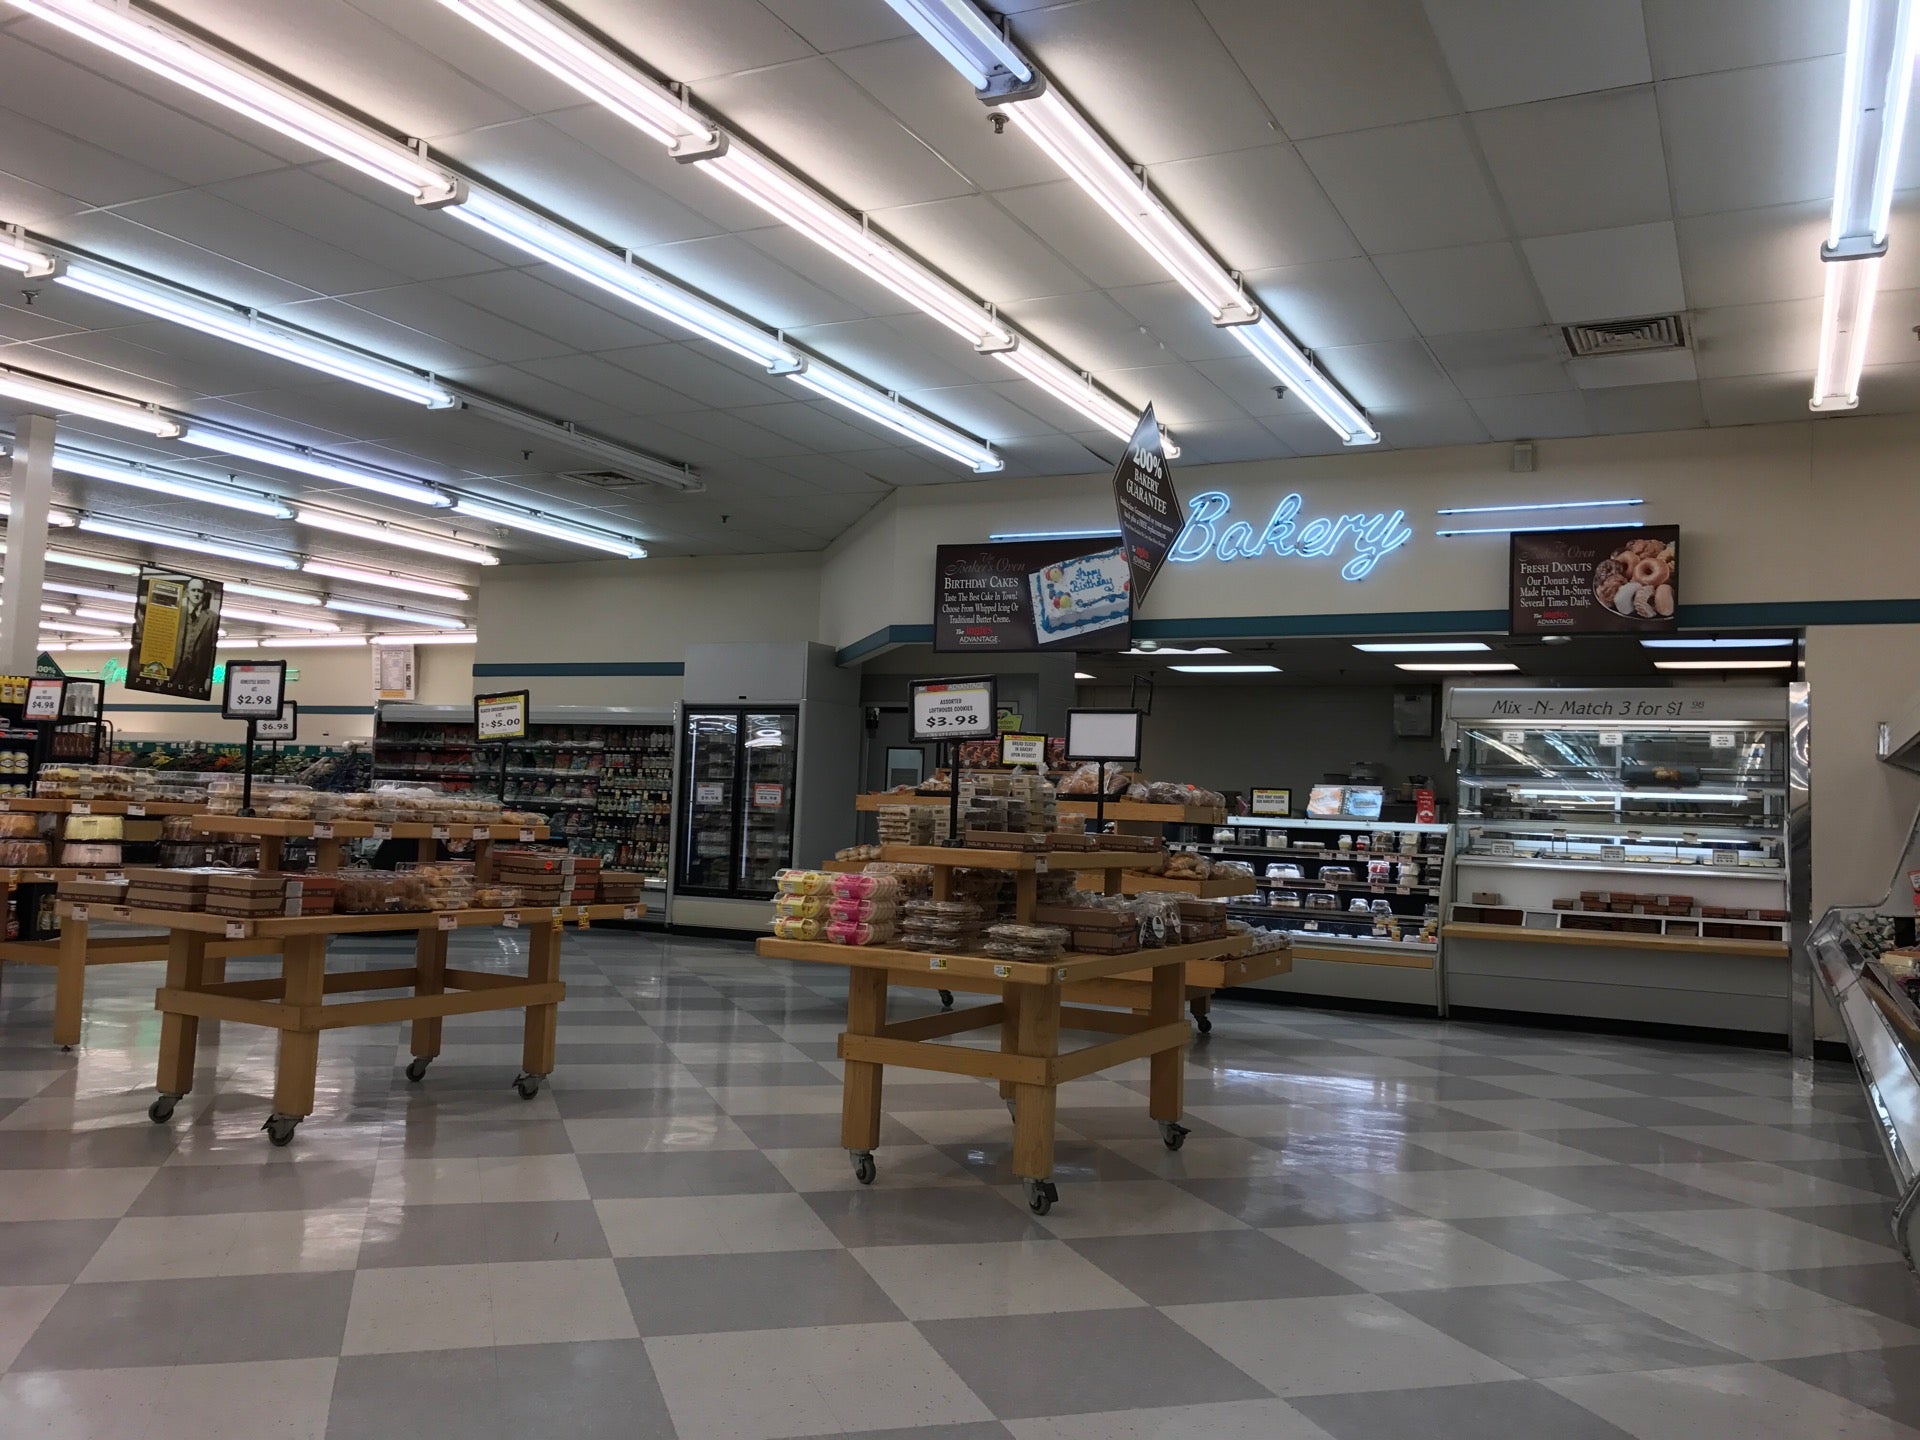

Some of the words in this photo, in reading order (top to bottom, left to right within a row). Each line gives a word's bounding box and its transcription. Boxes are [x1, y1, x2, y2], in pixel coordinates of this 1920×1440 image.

[1132, 442, 1163, 479] 200%
[1134, 467, 1160, 494] BAKERY
[1126, 478, 1167, 515] GUARANTEE
[1167, 490, 1412, 581] Bakery
[1075, 567, 1102, 581] Happy
[1520, 562, 1549, 574] FRESH
[1551, 561, 1592, 573] DONUTS
[944, 577, 988, 590] BIRTHDAY
[989, 575, 1019, 588] CAKES
[1069, 577, 1115, 593] Birthday
[1526, 575, 1541, 586] Our
[1543, 575, 1569, 586] Donuts
[1570, 574, 1585, 585] Are
[943, 592, 957, 602] Taste
[958, 592, 968, 601] The
[968, 591, 980, 601] Best
[980, 591, 994, 601] Cake
[994, 591, 1001, 600] In
[1001, 590, 1018, 601] Town!
[1519, 586, 1539, 597] Made
[1540, 586, 1561, 597] Fresh
[1562, 585, 1592, 596] In-Store
[942, 603, 960, 613] Choose
[960, 603, 975, 613] From
[974, 602, 997, 615] Whipped
[997, 602, 1011, 614] Icing
[1011, 602, 1019, 612] Or
[1520, 597, 1546, 608] Several
[1547, 596, 1569, 608] Times
[1570, 596, 1592, 609] Daily.
[949, 614, 975, 625] Traditional
[975, 614, 992, 624] Butter
[135, 677, 204, 693] PRODUCE
[31, 701, 55, 709] $4.98
[236, 694, 272, 705] $2.98
[1491, 700, 1522, 714] Mix
[1527, 700, 1555, 715] -N-
[1560, 700, 1613, 715] Match
[1618, 700, 1632, 716] 3
[1636, 700, 1663, 716] for
[1666, 701, 1683, 716] $1
[262, 723, 289, 731] $6.98
[490, 718, 521, 729] $5.00
[925, 714, 979, 729] $3.98
